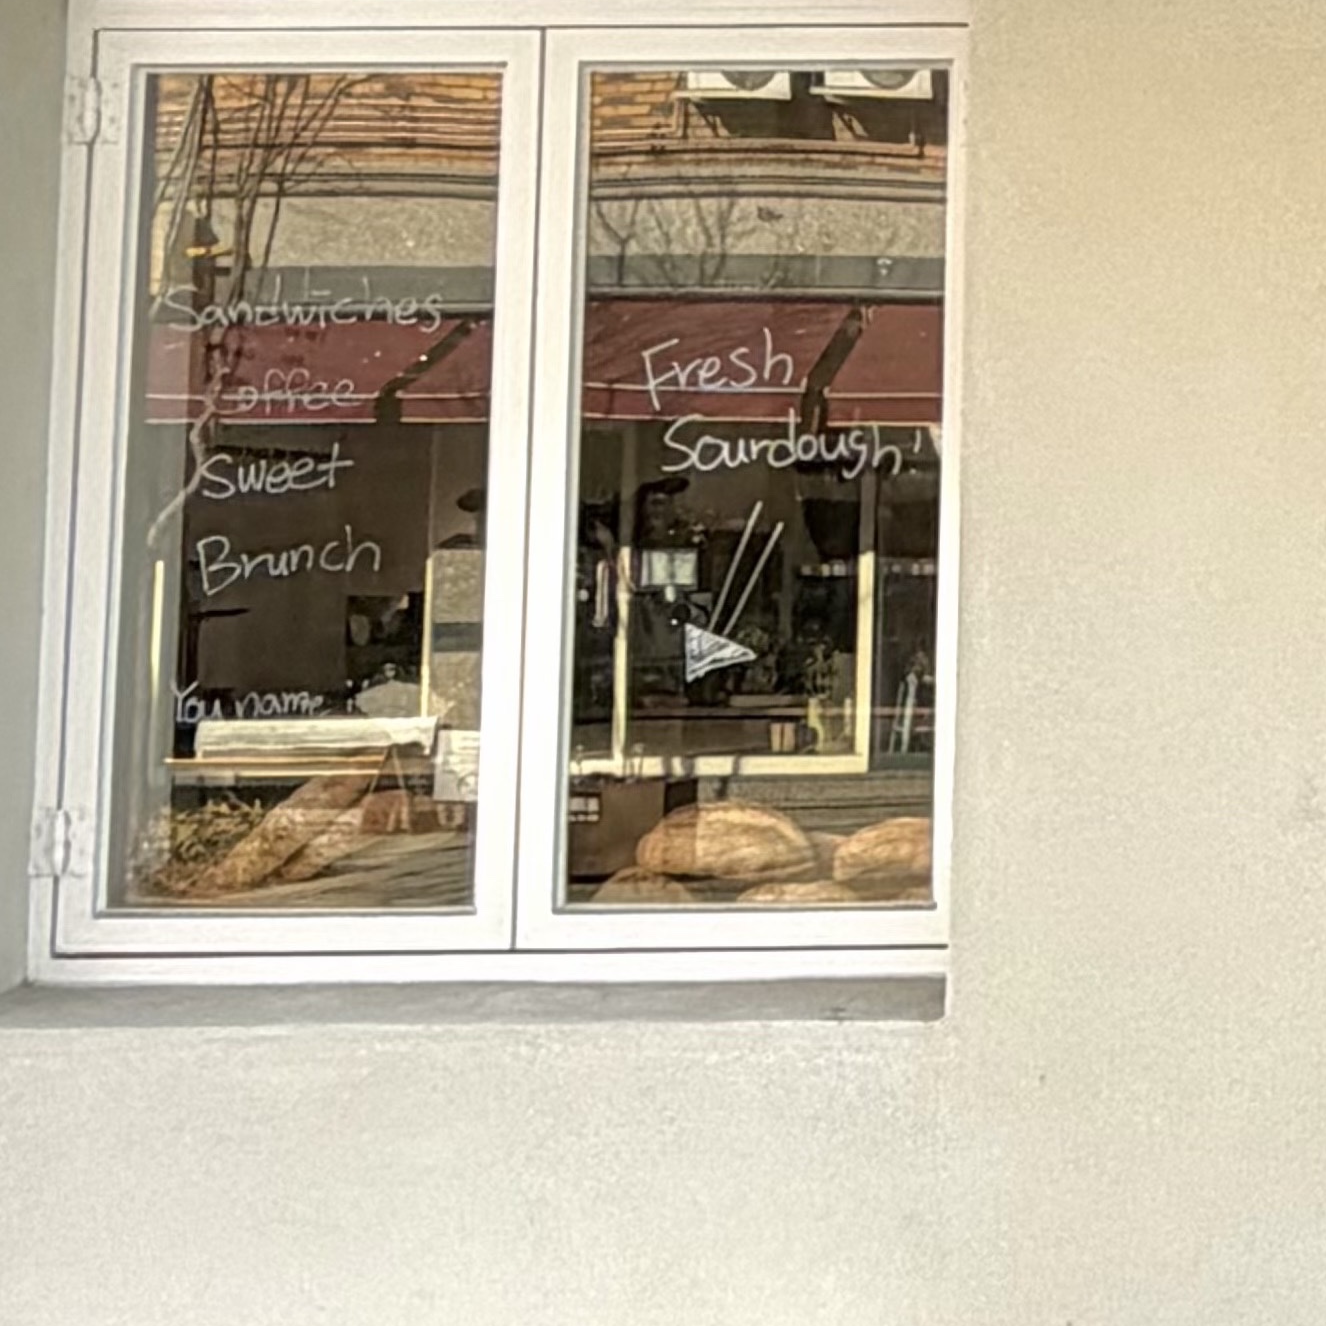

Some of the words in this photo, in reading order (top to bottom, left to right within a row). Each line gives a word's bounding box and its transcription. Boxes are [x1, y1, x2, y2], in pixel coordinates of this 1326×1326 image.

[164, 273, 442, 333] Sandwiches
[640, 327, 793, 410] Fresh
[200, 442, 354, 499] Sweet
[196, 526, 382, 596] Brunch
[169, 680, 222, 723] You
